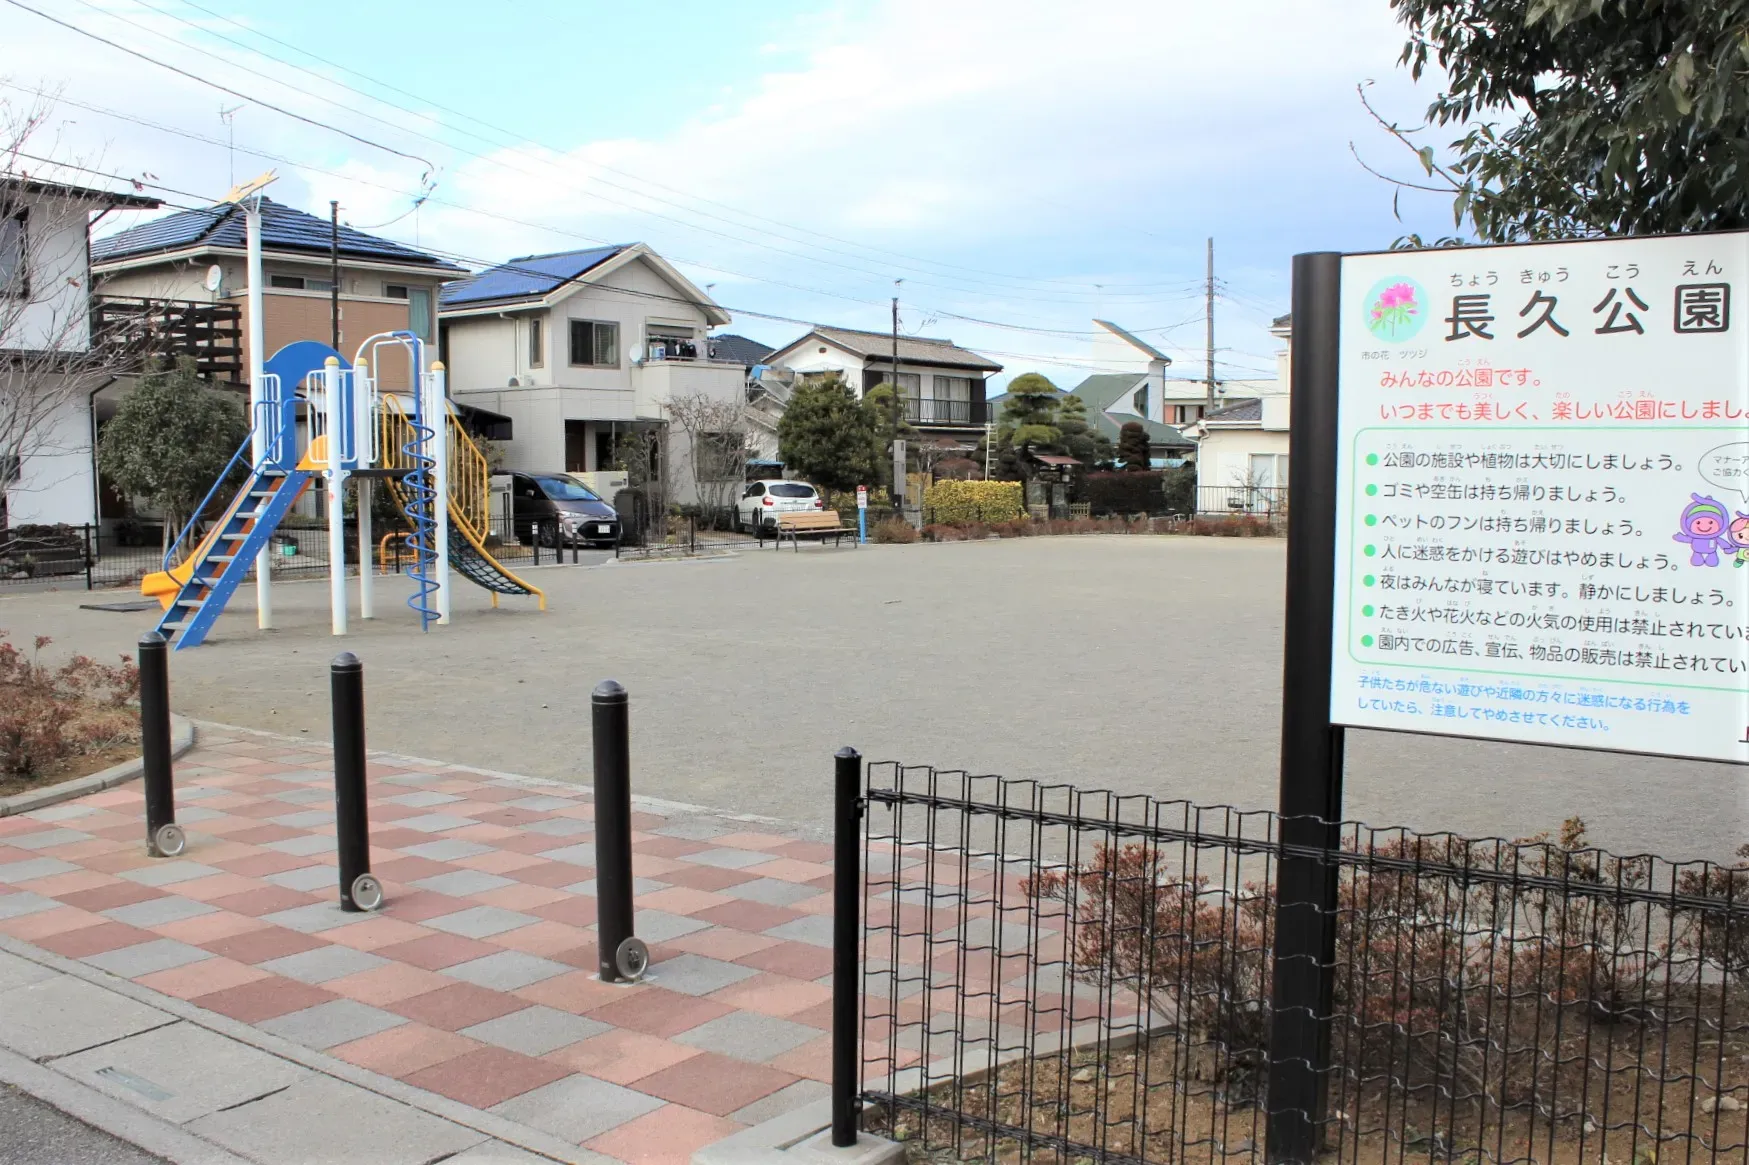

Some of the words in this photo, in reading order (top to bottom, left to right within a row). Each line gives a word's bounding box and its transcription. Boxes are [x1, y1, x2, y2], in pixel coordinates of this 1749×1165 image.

[1449, 271, 1499, 287] ちょう
[1519, 267, 1570, 284] きゅう
[1605, 263, 1641, 280] こう
[1681, 260, 1723, 276] えん
[1444, 282, 1731, 341] 長久公園
[1361, 350, 1390, 360] 市の花
[1399, 349, 1428, 359] ツツジ
[1380, 368, 1541, 388] みんなの公園です。
[1383, 452, 1682, 471] 公園の施設や植物は大切にしましょう。
[1383, 482, 1626, 504] ゴミや空缶は持ち帰りましょう。
[1382, 514, 1643, 537] ペットのフンは持ち帰りましょう。
[1381, 543, 1678, 572] 人に迷惑をかける遊びはやめましょう。
[1357, 675, 1691, 715] 子供たちが危ない遊びや近隣の方々に迷惑になる行為を
[1357, 697, 1610, 731] していたら、注意してやめさせてください。
